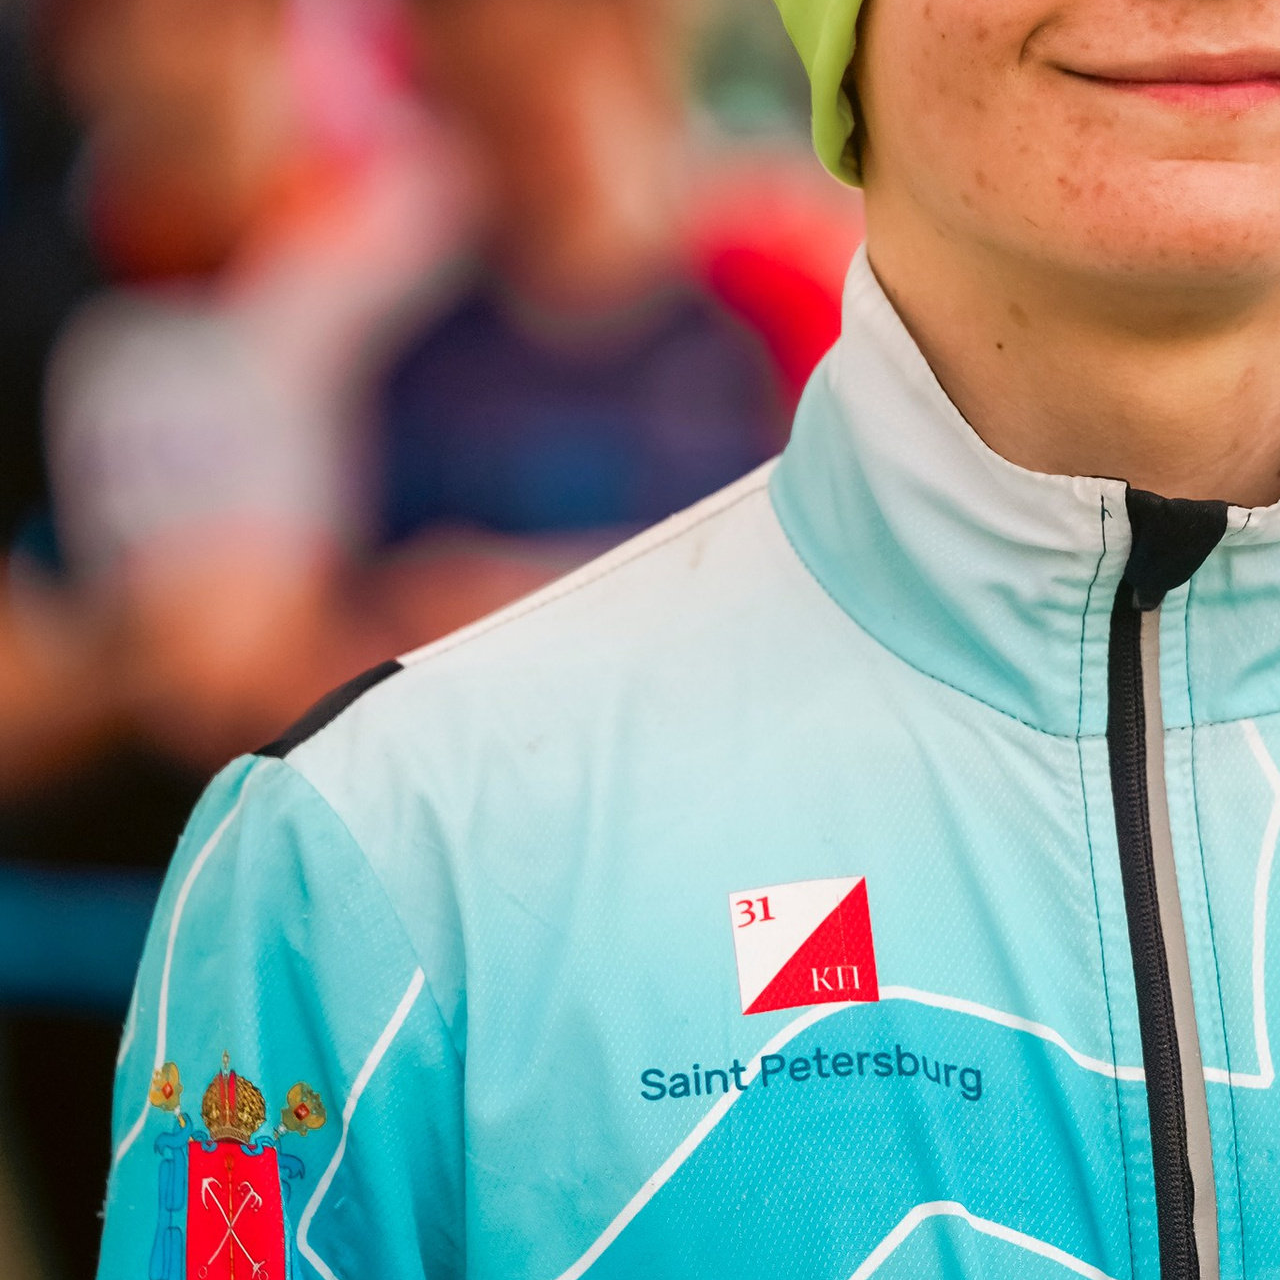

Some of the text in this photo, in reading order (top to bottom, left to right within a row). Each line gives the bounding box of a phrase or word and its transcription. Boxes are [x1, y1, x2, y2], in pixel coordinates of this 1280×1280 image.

[735, 896, 776, 928] 31
[811, 965, 861, 992] КП
[640, 1044, 983, 1101] Saint Petersburg
